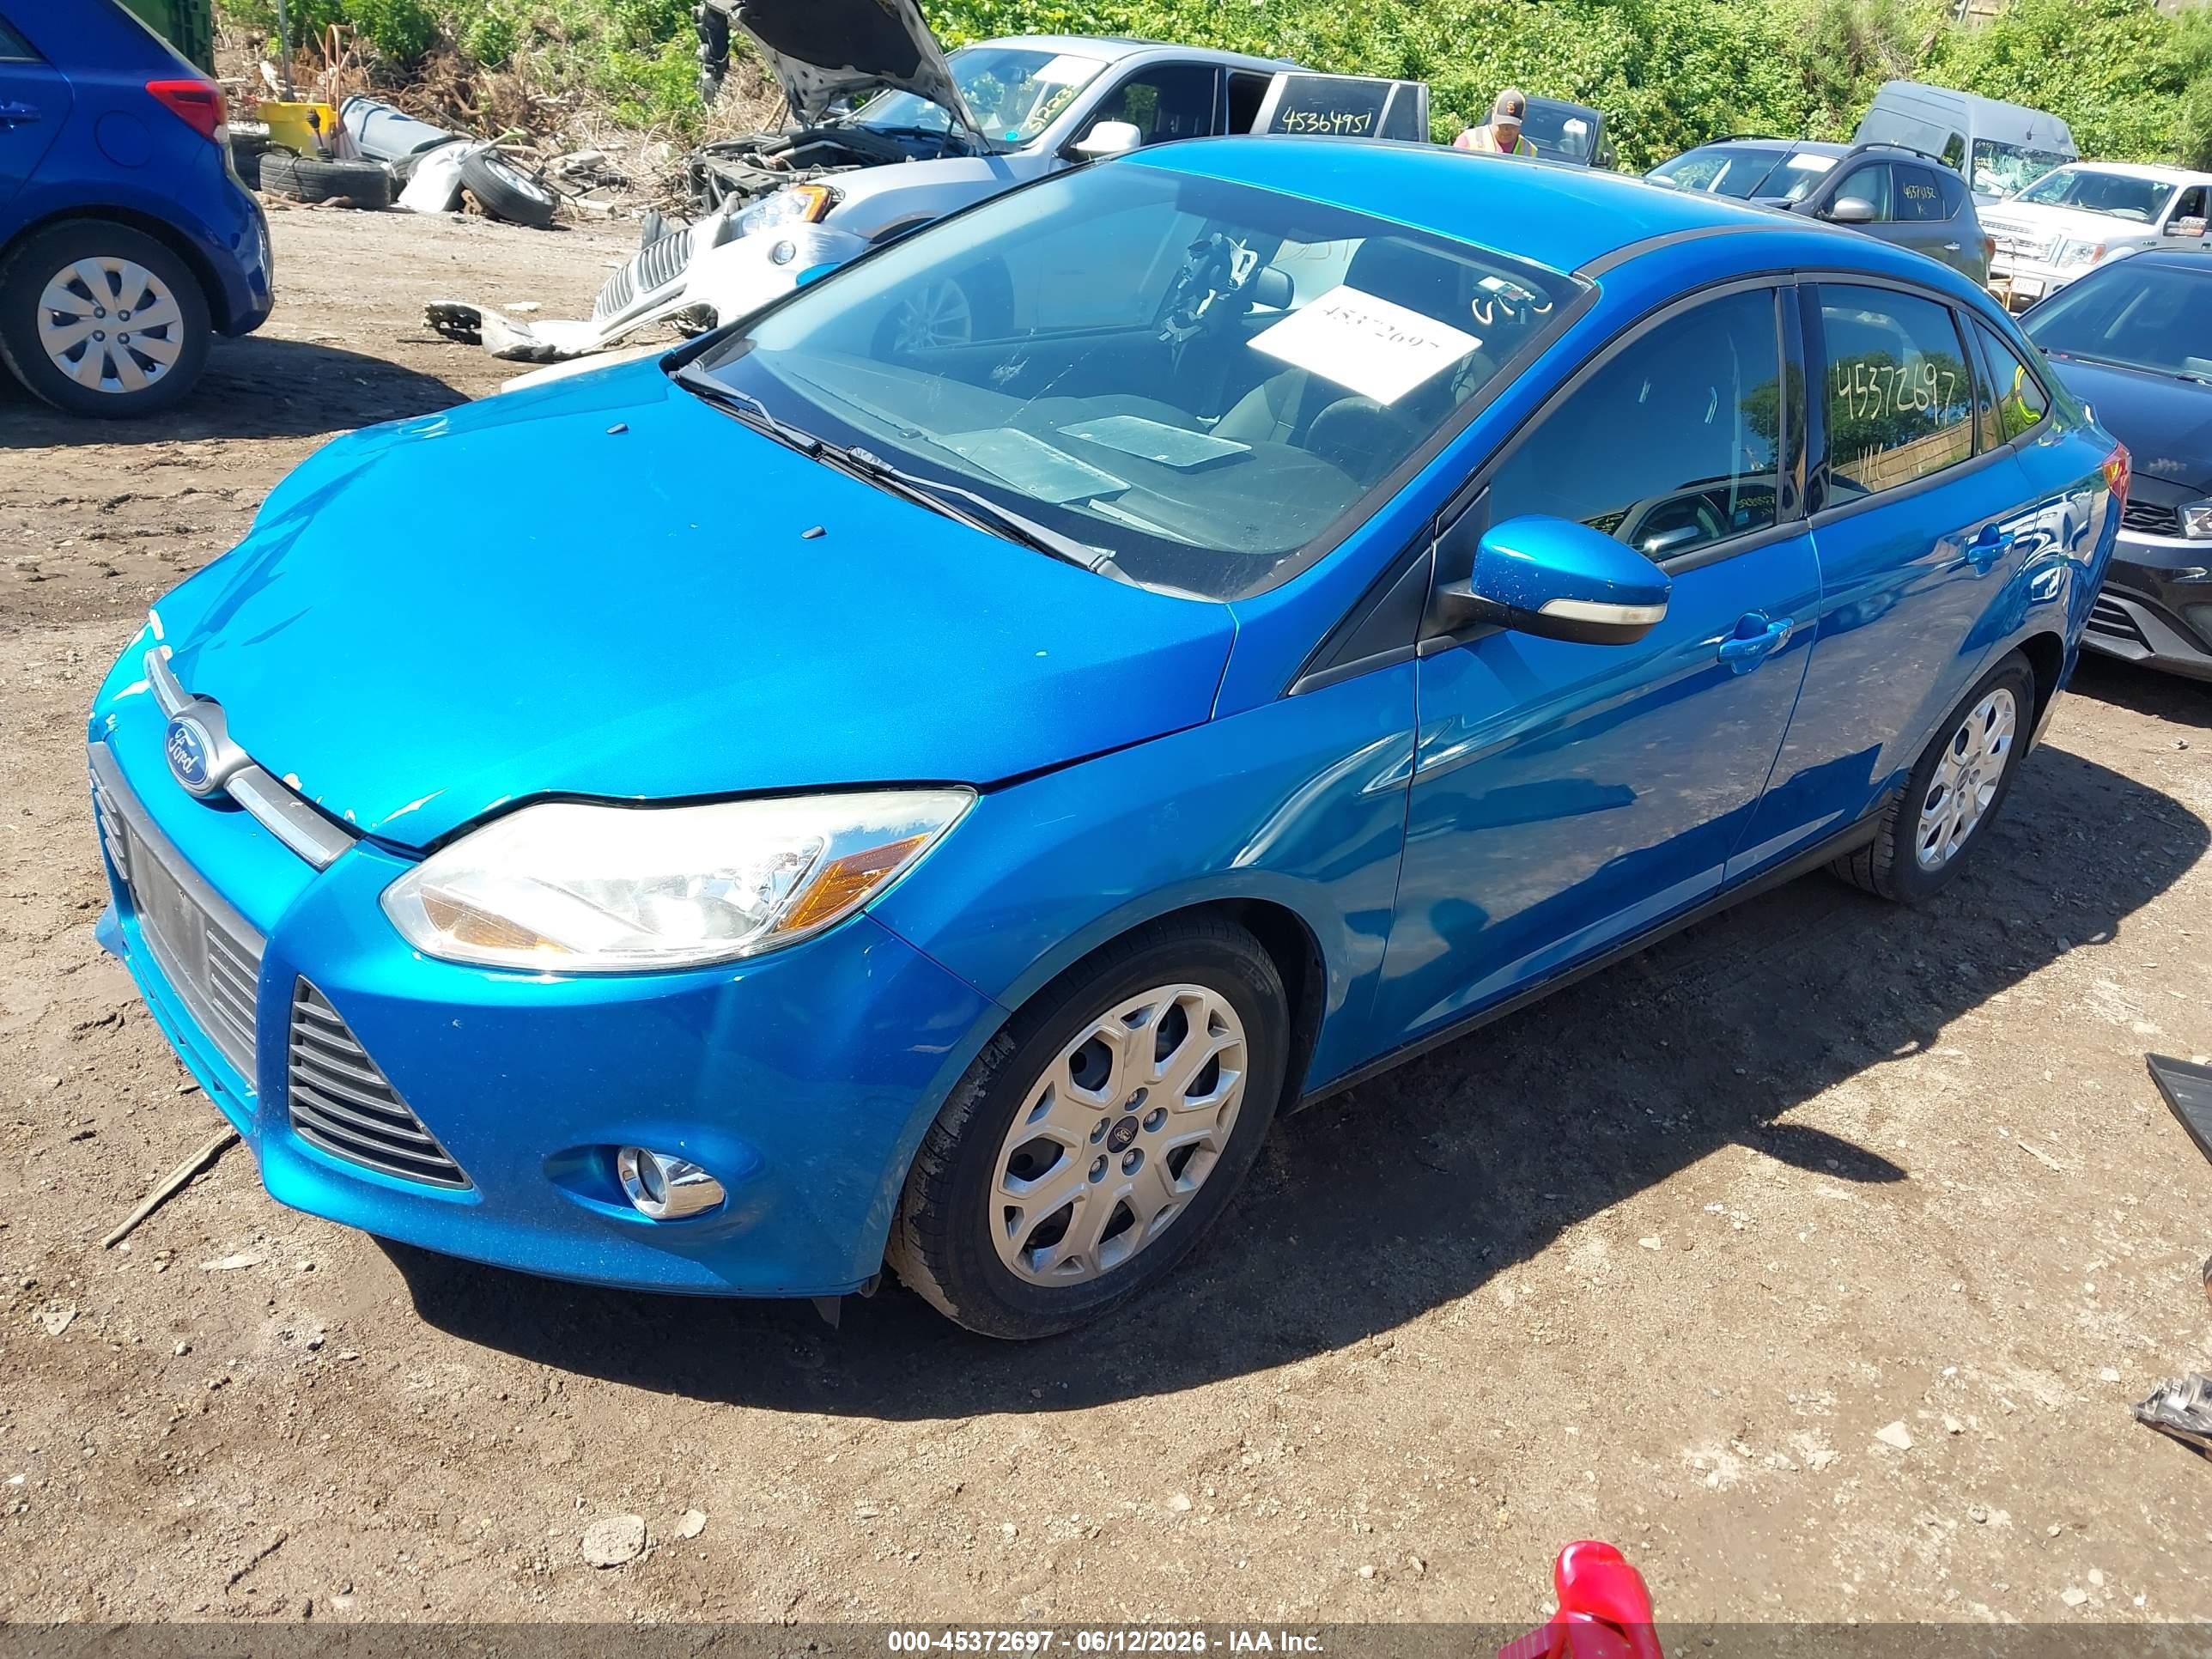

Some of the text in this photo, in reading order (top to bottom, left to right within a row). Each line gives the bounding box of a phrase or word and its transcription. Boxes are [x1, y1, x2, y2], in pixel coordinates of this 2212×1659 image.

[1281, 106, 1372, 135] 45364951
[1836, 359, 1956, 428] 45372697
[167, 727, 199, 774] Ford
